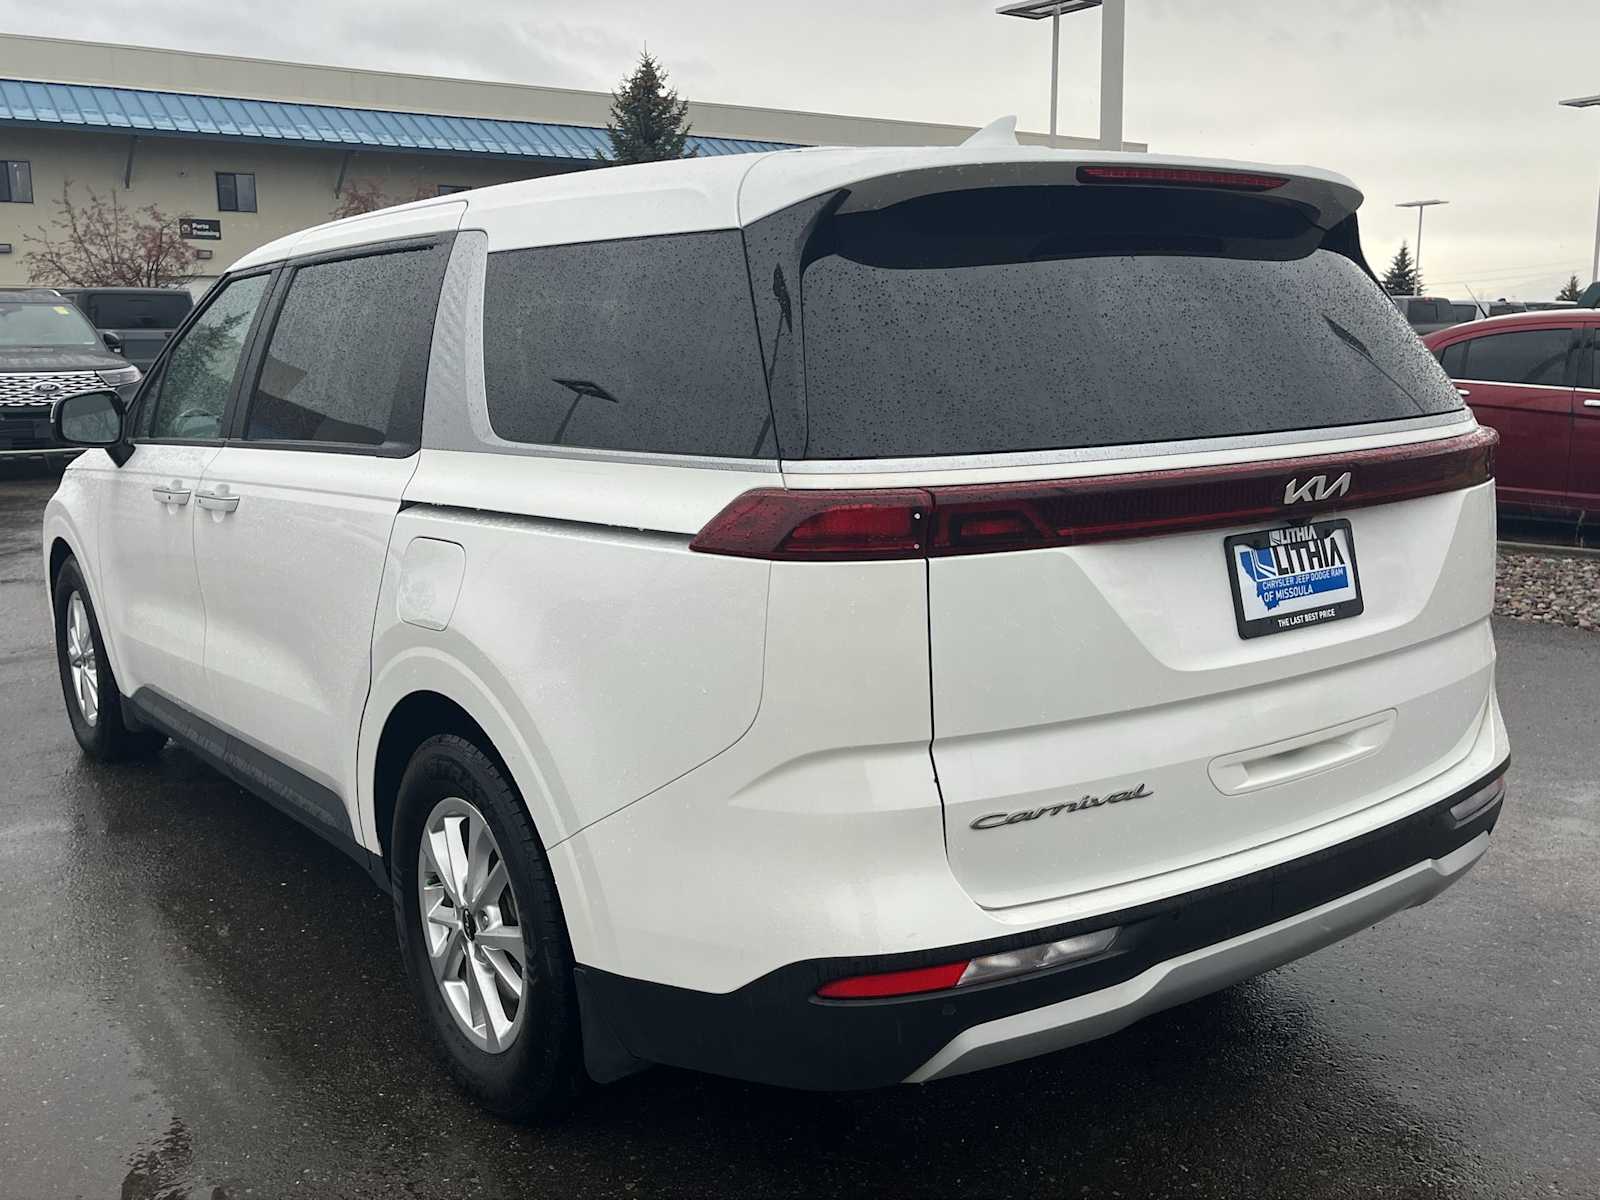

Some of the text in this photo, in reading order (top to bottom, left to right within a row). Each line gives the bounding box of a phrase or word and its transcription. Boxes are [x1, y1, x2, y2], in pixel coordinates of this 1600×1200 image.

[1280, 525, 1318, 544] LITHIA
[1272, 537, 1345, 575] LITHIA
[1262, 567, 1344, 590] CHRYSLER JEEP DODGE RAM
[1263, 584, 1314, 602] OF MISSOULA
[1278, 608, 1336, 628] THE LAST BEST PRICE
[969, 783, 1154, 830] Carnival
